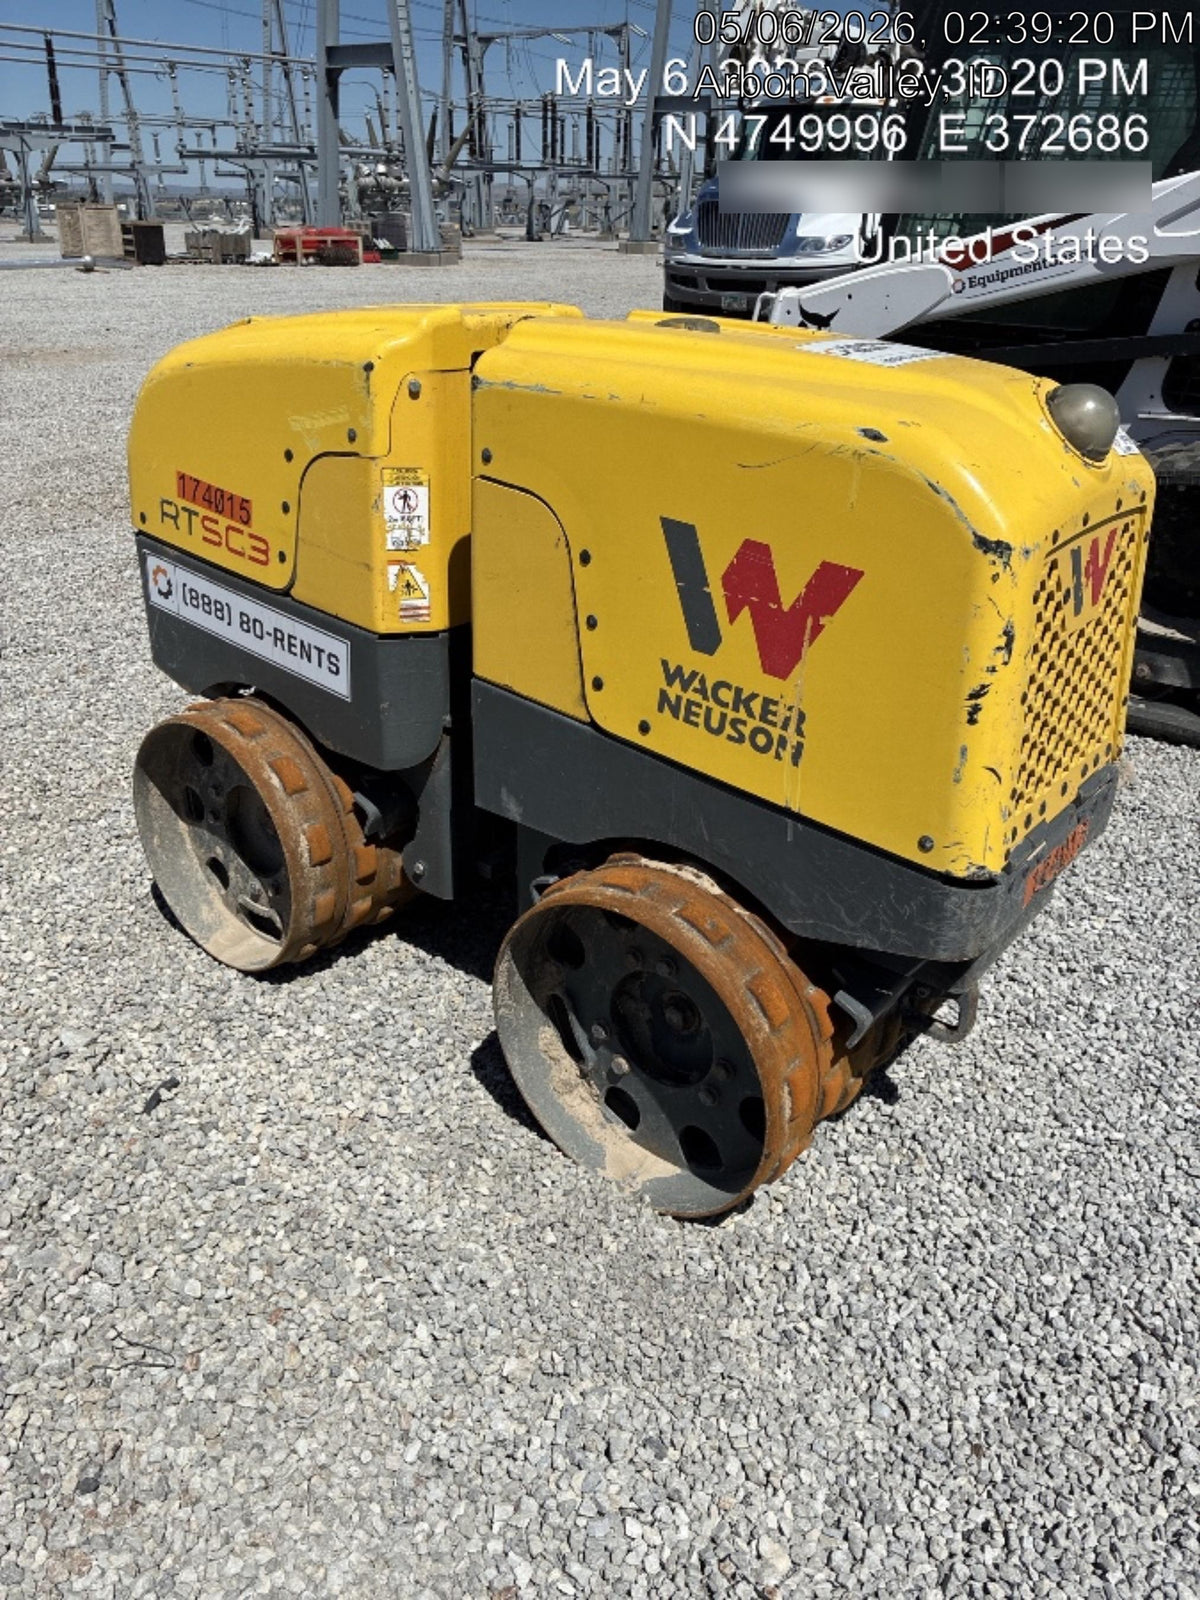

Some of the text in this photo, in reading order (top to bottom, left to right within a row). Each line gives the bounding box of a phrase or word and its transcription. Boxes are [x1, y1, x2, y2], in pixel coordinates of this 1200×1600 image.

[160, 497, 270, 567] RTSC3
[177, 472, 252, 527] 174015
[181, 582, 341, 677] (888) 80-RENTS
[656, 688, 805, 769] NEUSON
[659, 657, 806, 739] WACKER
